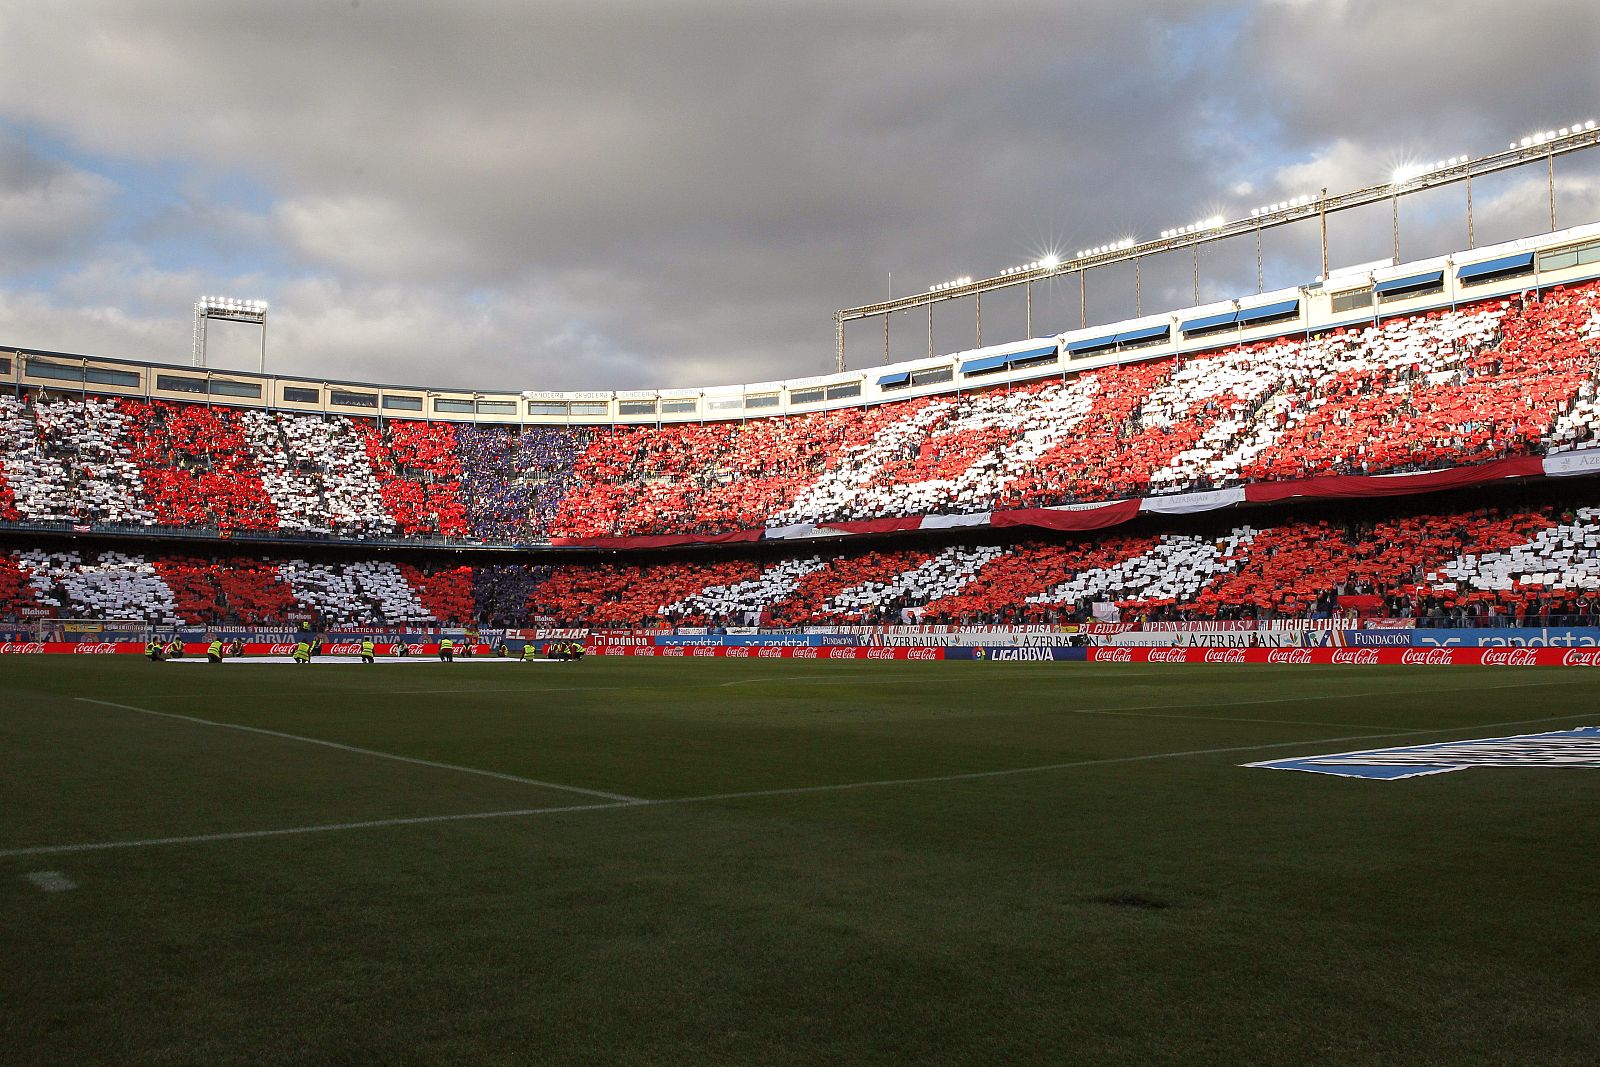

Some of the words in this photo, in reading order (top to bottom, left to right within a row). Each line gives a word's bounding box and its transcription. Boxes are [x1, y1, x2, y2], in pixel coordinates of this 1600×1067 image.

[22, 607, 50, 616] Mahou
[287, 612, 312, 620] Mahou
[959, 624, 988, 634] SANTA
[991, 624, 1009, 634] ANA
[1012, 624, 1024, 633] DE
[1026, 624, 1051, 633] PUSA
[1188, 620, 1245, 632] CANILLAS
[1271, 618, 1358, 631] MIGUELTURRA
[505, 628, 526, 639] EL
[535, 628, 590, 639] GUIJAR
[1354, 632, 1411, 645] FUNDACIÓN
[764, 636, 810, 646] randstad
[73, 642, 118, 654] Coca-Cola
[725, 646, 749, 658] Coca-Cola
[758, 646, 782, 658] Coca-Cola
[792, 646, 818, 659] Coca-Cola
[829, 646, 857, 659] Coca-Cola
[867, 647, 895, 660] Coca-Cola
[907, 647, 937, 660] Coca-Cola
[1094, 647, 1133, 662] Coca-Cola
[1147, 647, 1188, 663] Coca-Cola
[1204, 648, 1247, 663] Coca-Cola
[1267, 648, 1313, 664] Coca-Cola
[1331, 648, 1381, 665] Coca-Cola
[1401, 648, 1455, 665] Coca-Cola
[1480, 648, 1539, 666] Coca-Cola
